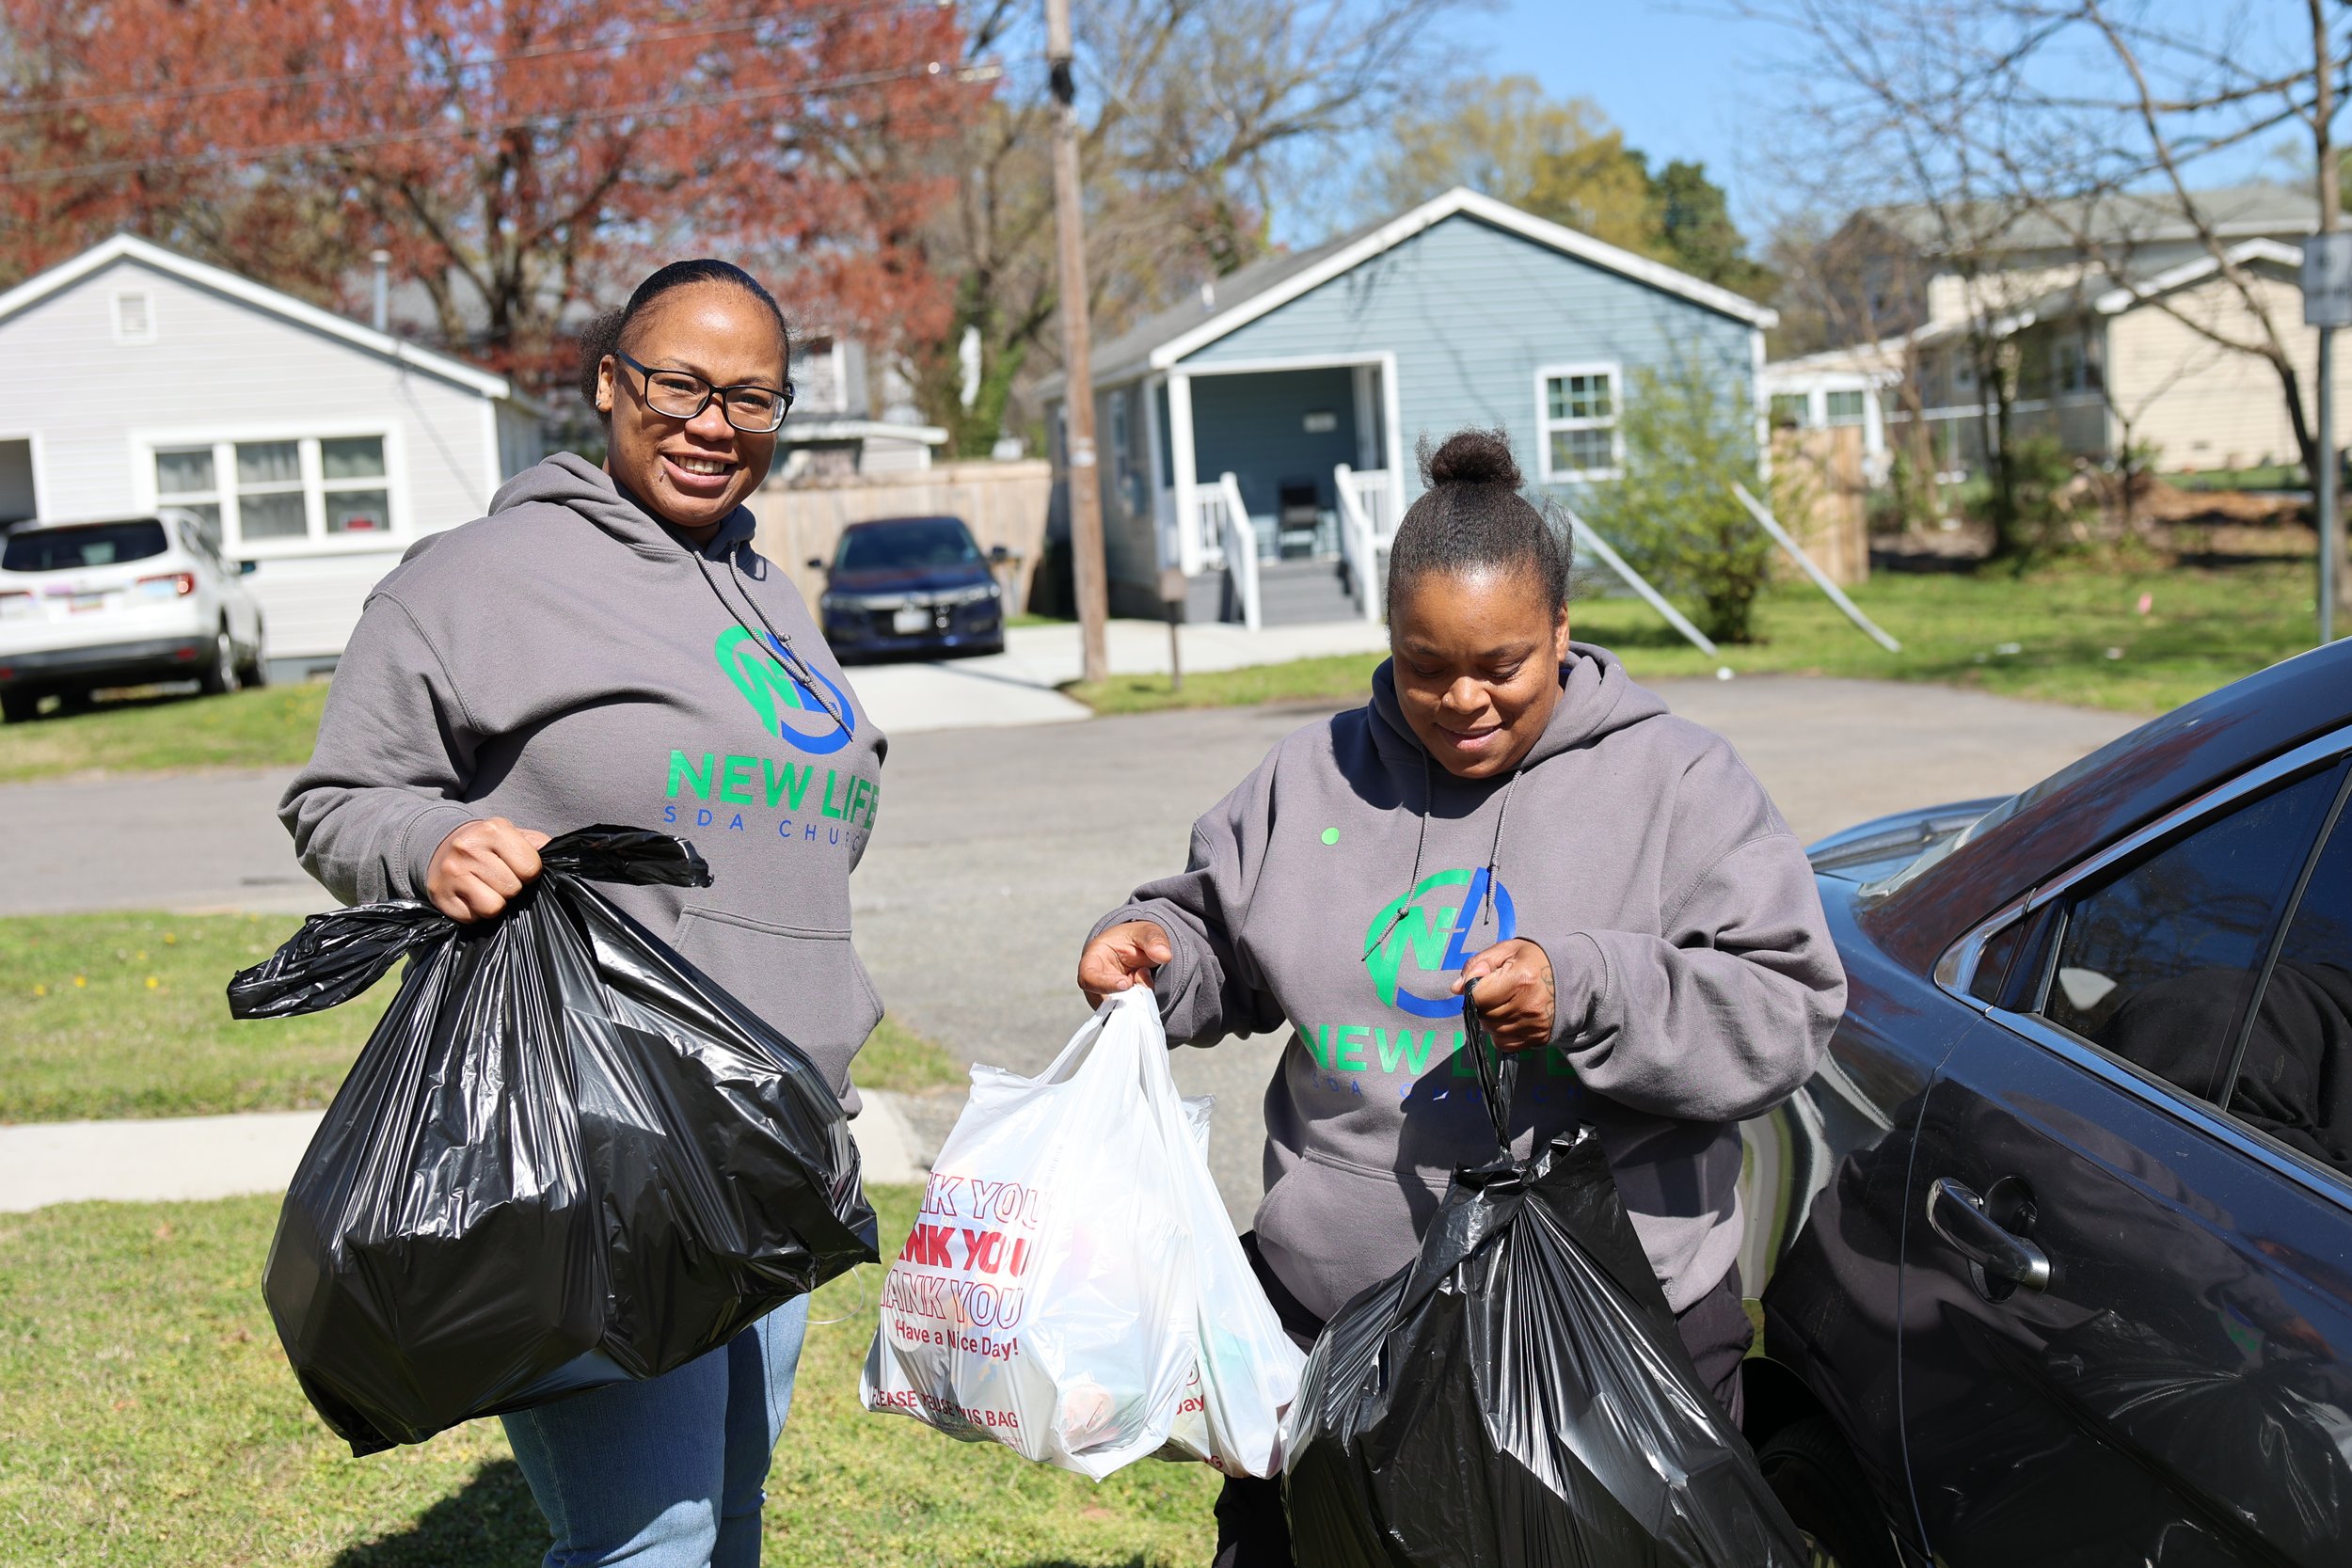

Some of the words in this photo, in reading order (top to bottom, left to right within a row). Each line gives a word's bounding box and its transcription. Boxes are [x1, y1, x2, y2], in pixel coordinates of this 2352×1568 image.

[666, 750, 814, 812] NEW
[1299, 1023, 1436, 1075] NEW
[1399, 1083, 1582, 1103] CHUCH
[972, 1180, 1044, 1229] YOU
[898, 1224, 956, 1268] NK
[961, 1228, 1032, 1277] YOU
[881, 1269, 946, 1320] ANK
[950, 1279, 1024, 1329] YOU
[895, 1320, 930, 1343] Have
[934, 1331, 943, 1345] a
[947, 1329, 977, 1353] Nice
[981, 1337, 1019, 1361] Day!
[985, 1410, 1019, 1428] BAG
